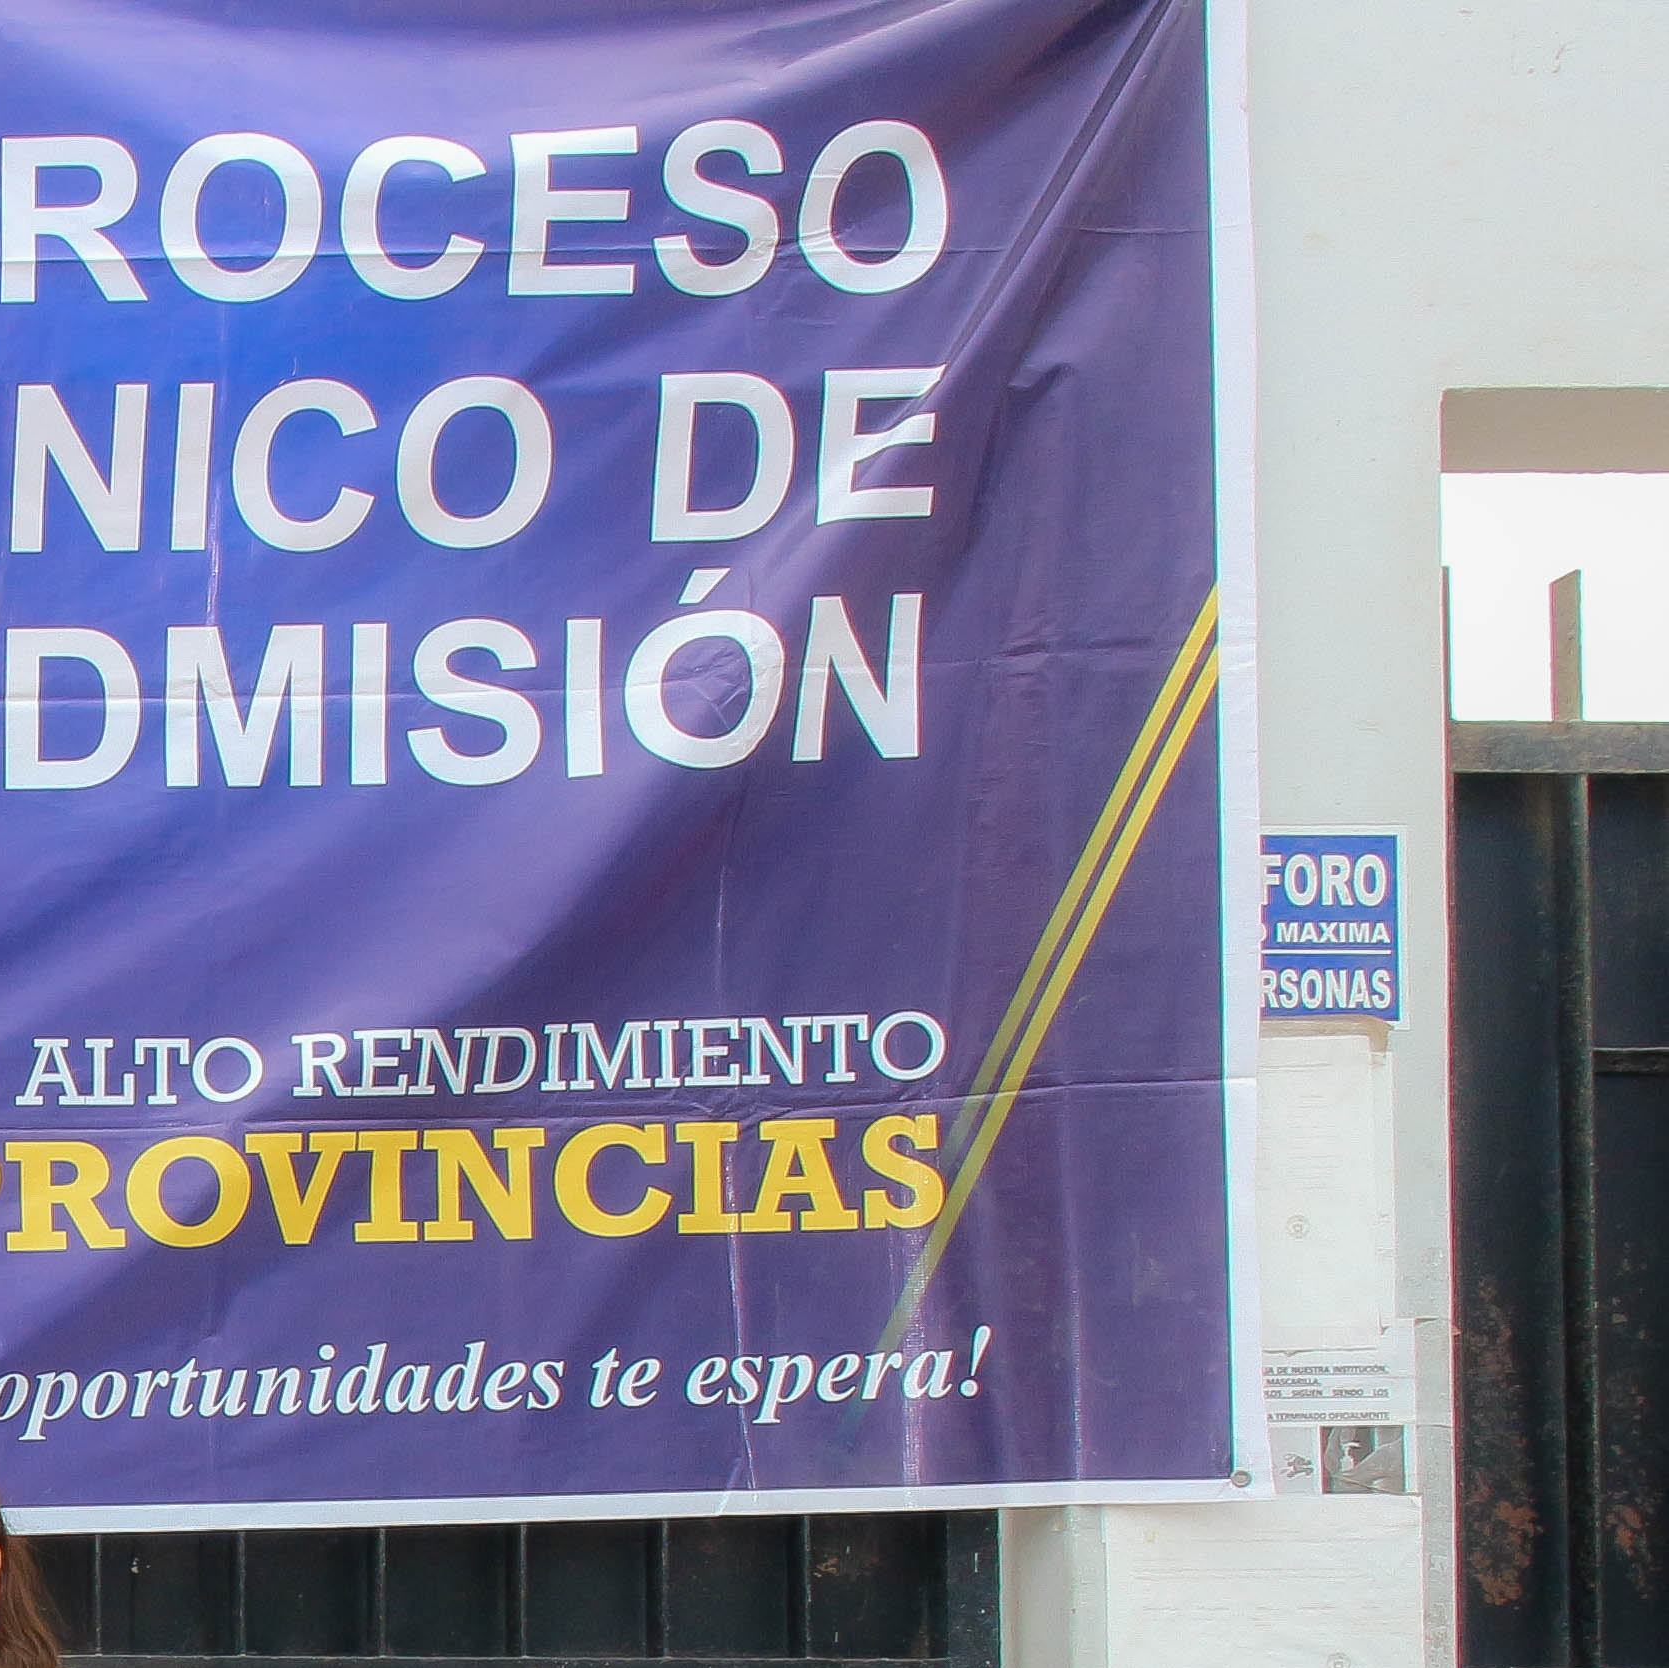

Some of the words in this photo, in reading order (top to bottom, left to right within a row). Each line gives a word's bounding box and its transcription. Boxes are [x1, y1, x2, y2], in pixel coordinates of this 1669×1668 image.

[650, 364, 947, 543] DE
[1276, 922, 1391, 944] MAXIMA
[15, 1037, 263, 1105] ALTO
[292, 1011, 946, 1098] RENDIMIENTO
[588, 1346, 657, 1403] te
[685, 1325, 995, 1424] espera!
